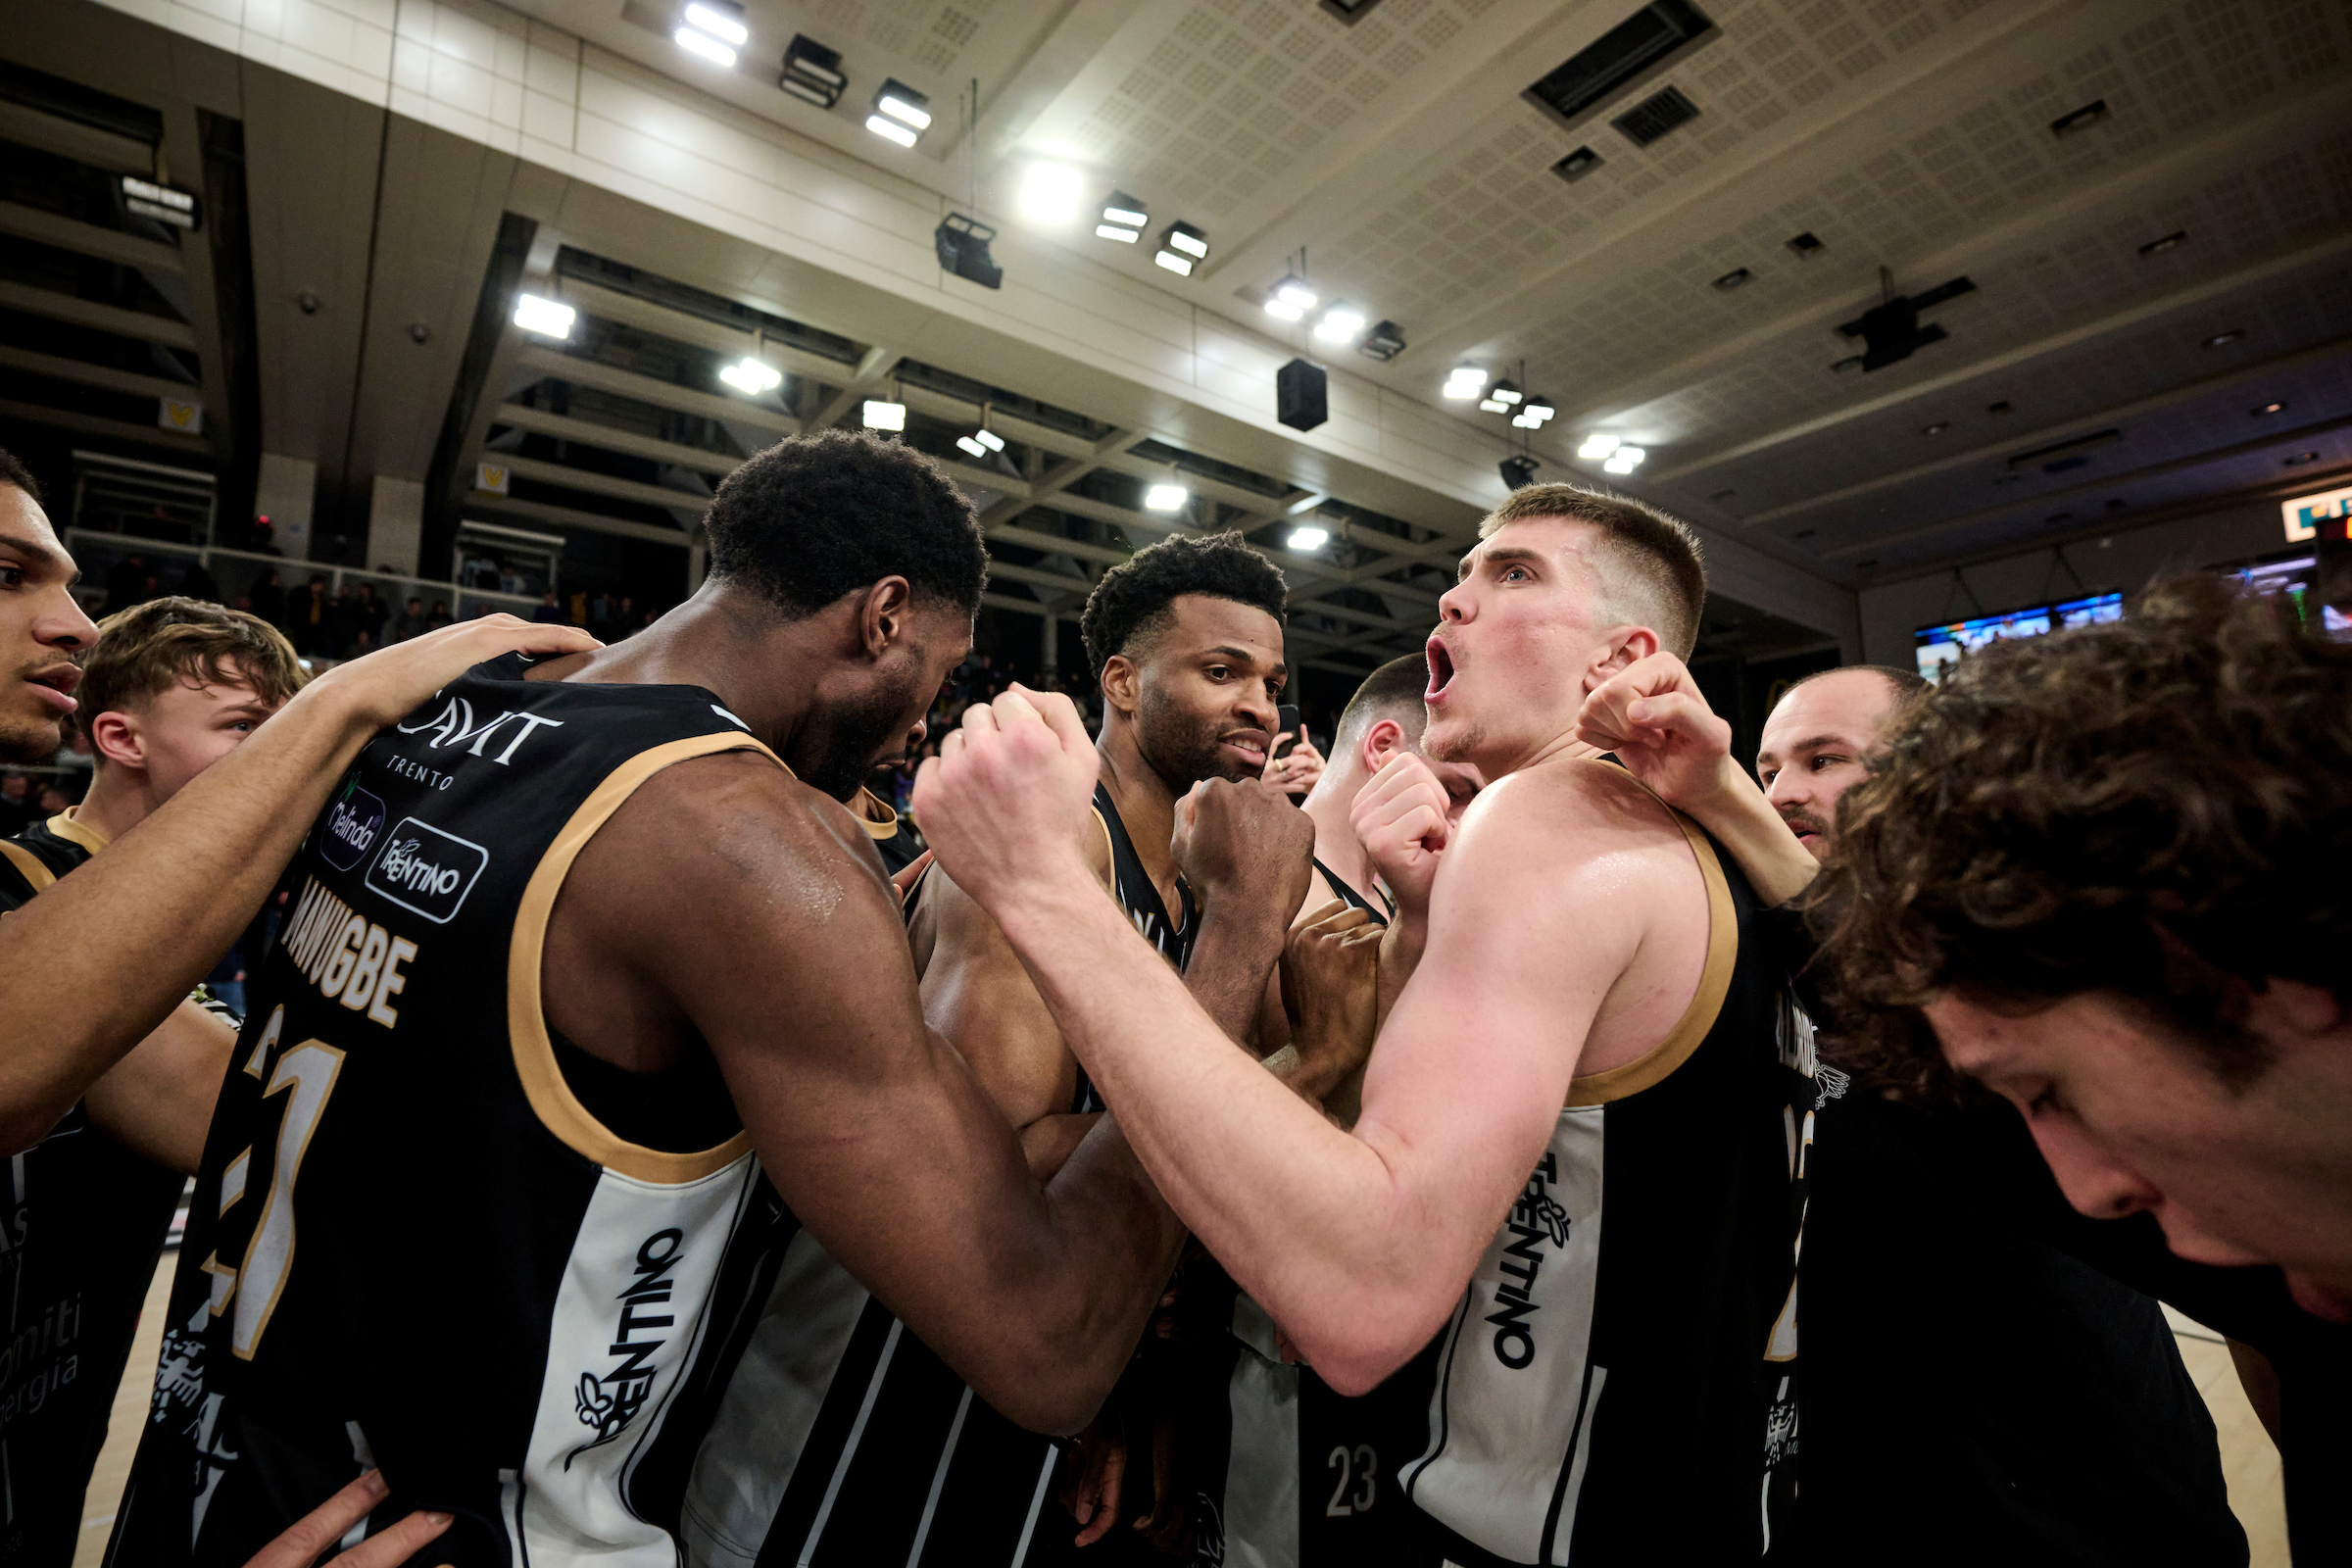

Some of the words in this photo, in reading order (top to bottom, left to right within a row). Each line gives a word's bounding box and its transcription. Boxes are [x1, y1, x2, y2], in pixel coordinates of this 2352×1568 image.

[386, 745, 454, 791] TRENTO
[327, 801, 374, 852] Melinda
[379, 839, 461, 897] TRENTINO
[1326, 1444, 1378, 1517] 23
